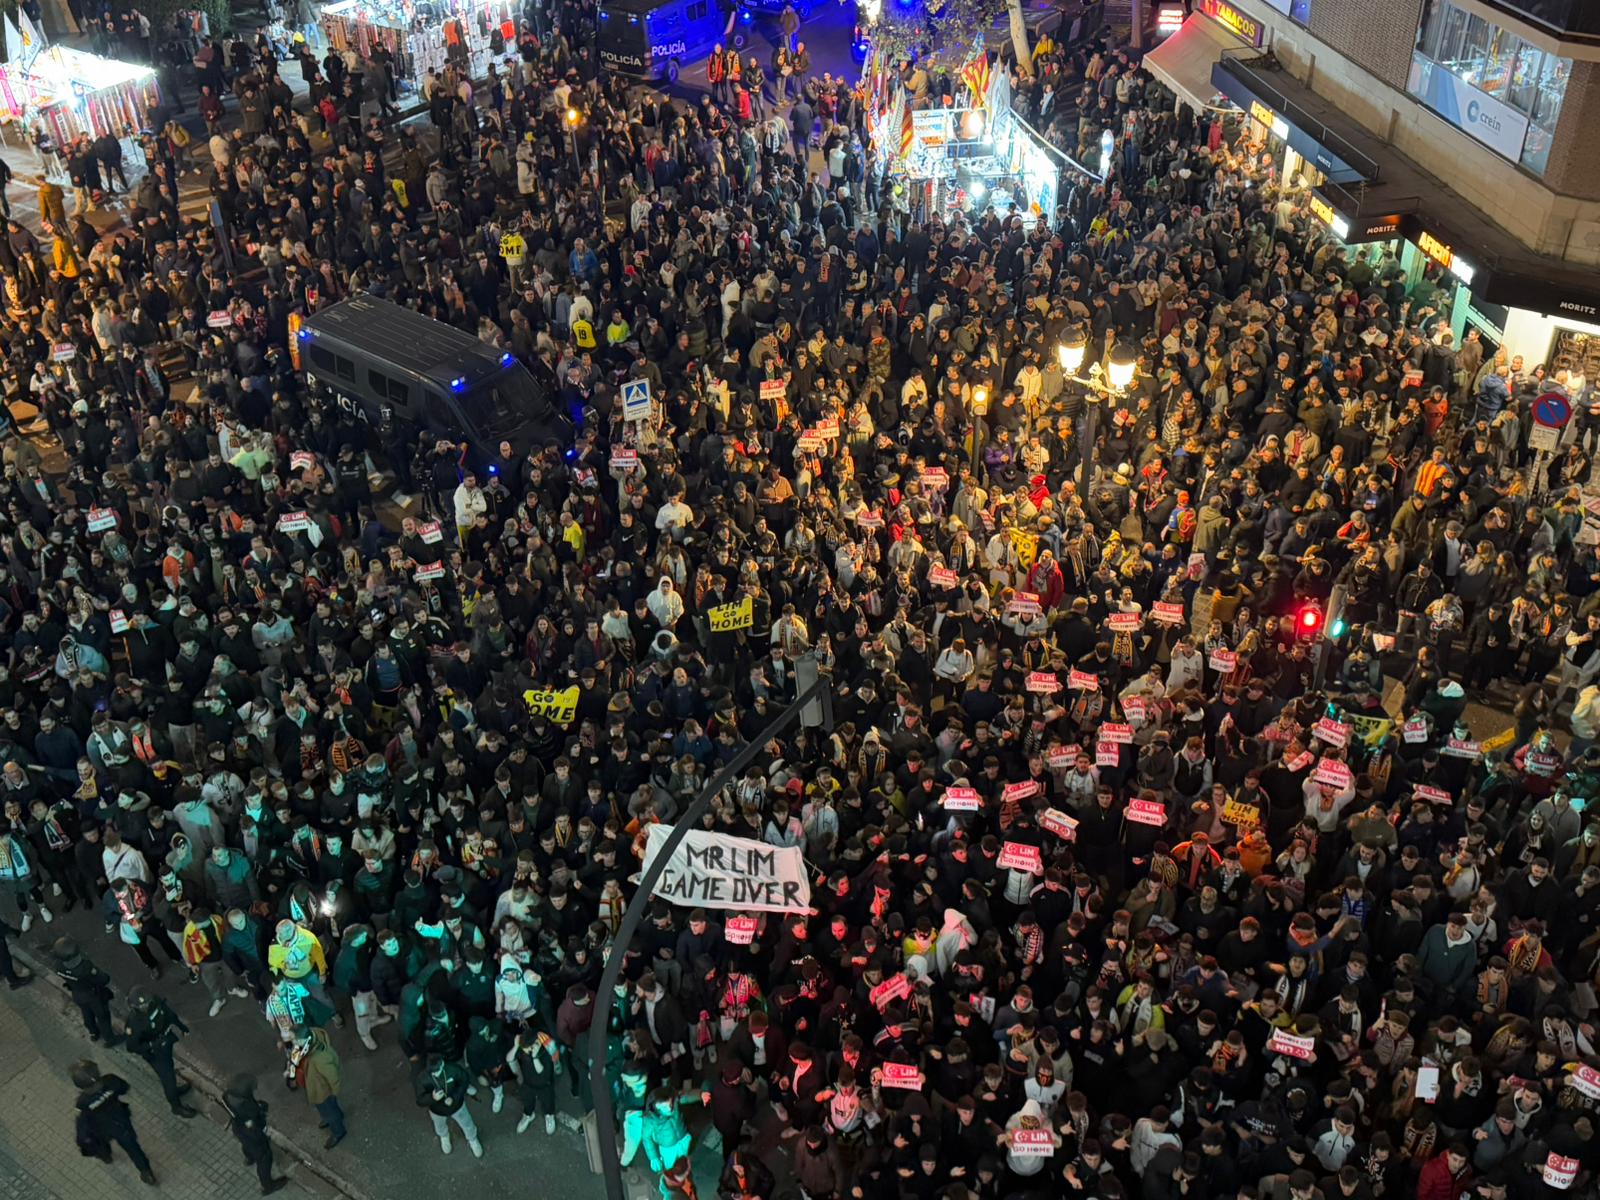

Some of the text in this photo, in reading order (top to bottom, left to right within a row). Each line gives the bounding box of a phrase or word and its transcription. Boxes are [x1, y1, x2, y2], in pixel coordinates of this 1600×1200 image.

[1216, 1, 1255, 37] TABACOS
[652, 40, 686, 57] POLICÍA
[600, 51, 642, 66] POLICÍA
[1480, 113, 1501, 132] crein
[1366, 225, 1397, 235] MORITZ
[1560, 301, 1596, 315] MORITZ
[578, 329, 587, 340] 19
[307, 371, 369, 424] PICÍA
[722, 610, 738, 618] GO
[711, 614, 751, 630] HOME
[533, 692, 554, 704] GO
[528, 703, 574, 720] OME
[1230, 803, 1252, 815] LIM
[1222, 813, 1255, 827] HOME
[686, 842, 775, 878] MR LIM
[659, 869, 803, 908] GAME OVER
[1275, 1043, 1291, 1051] LIM
